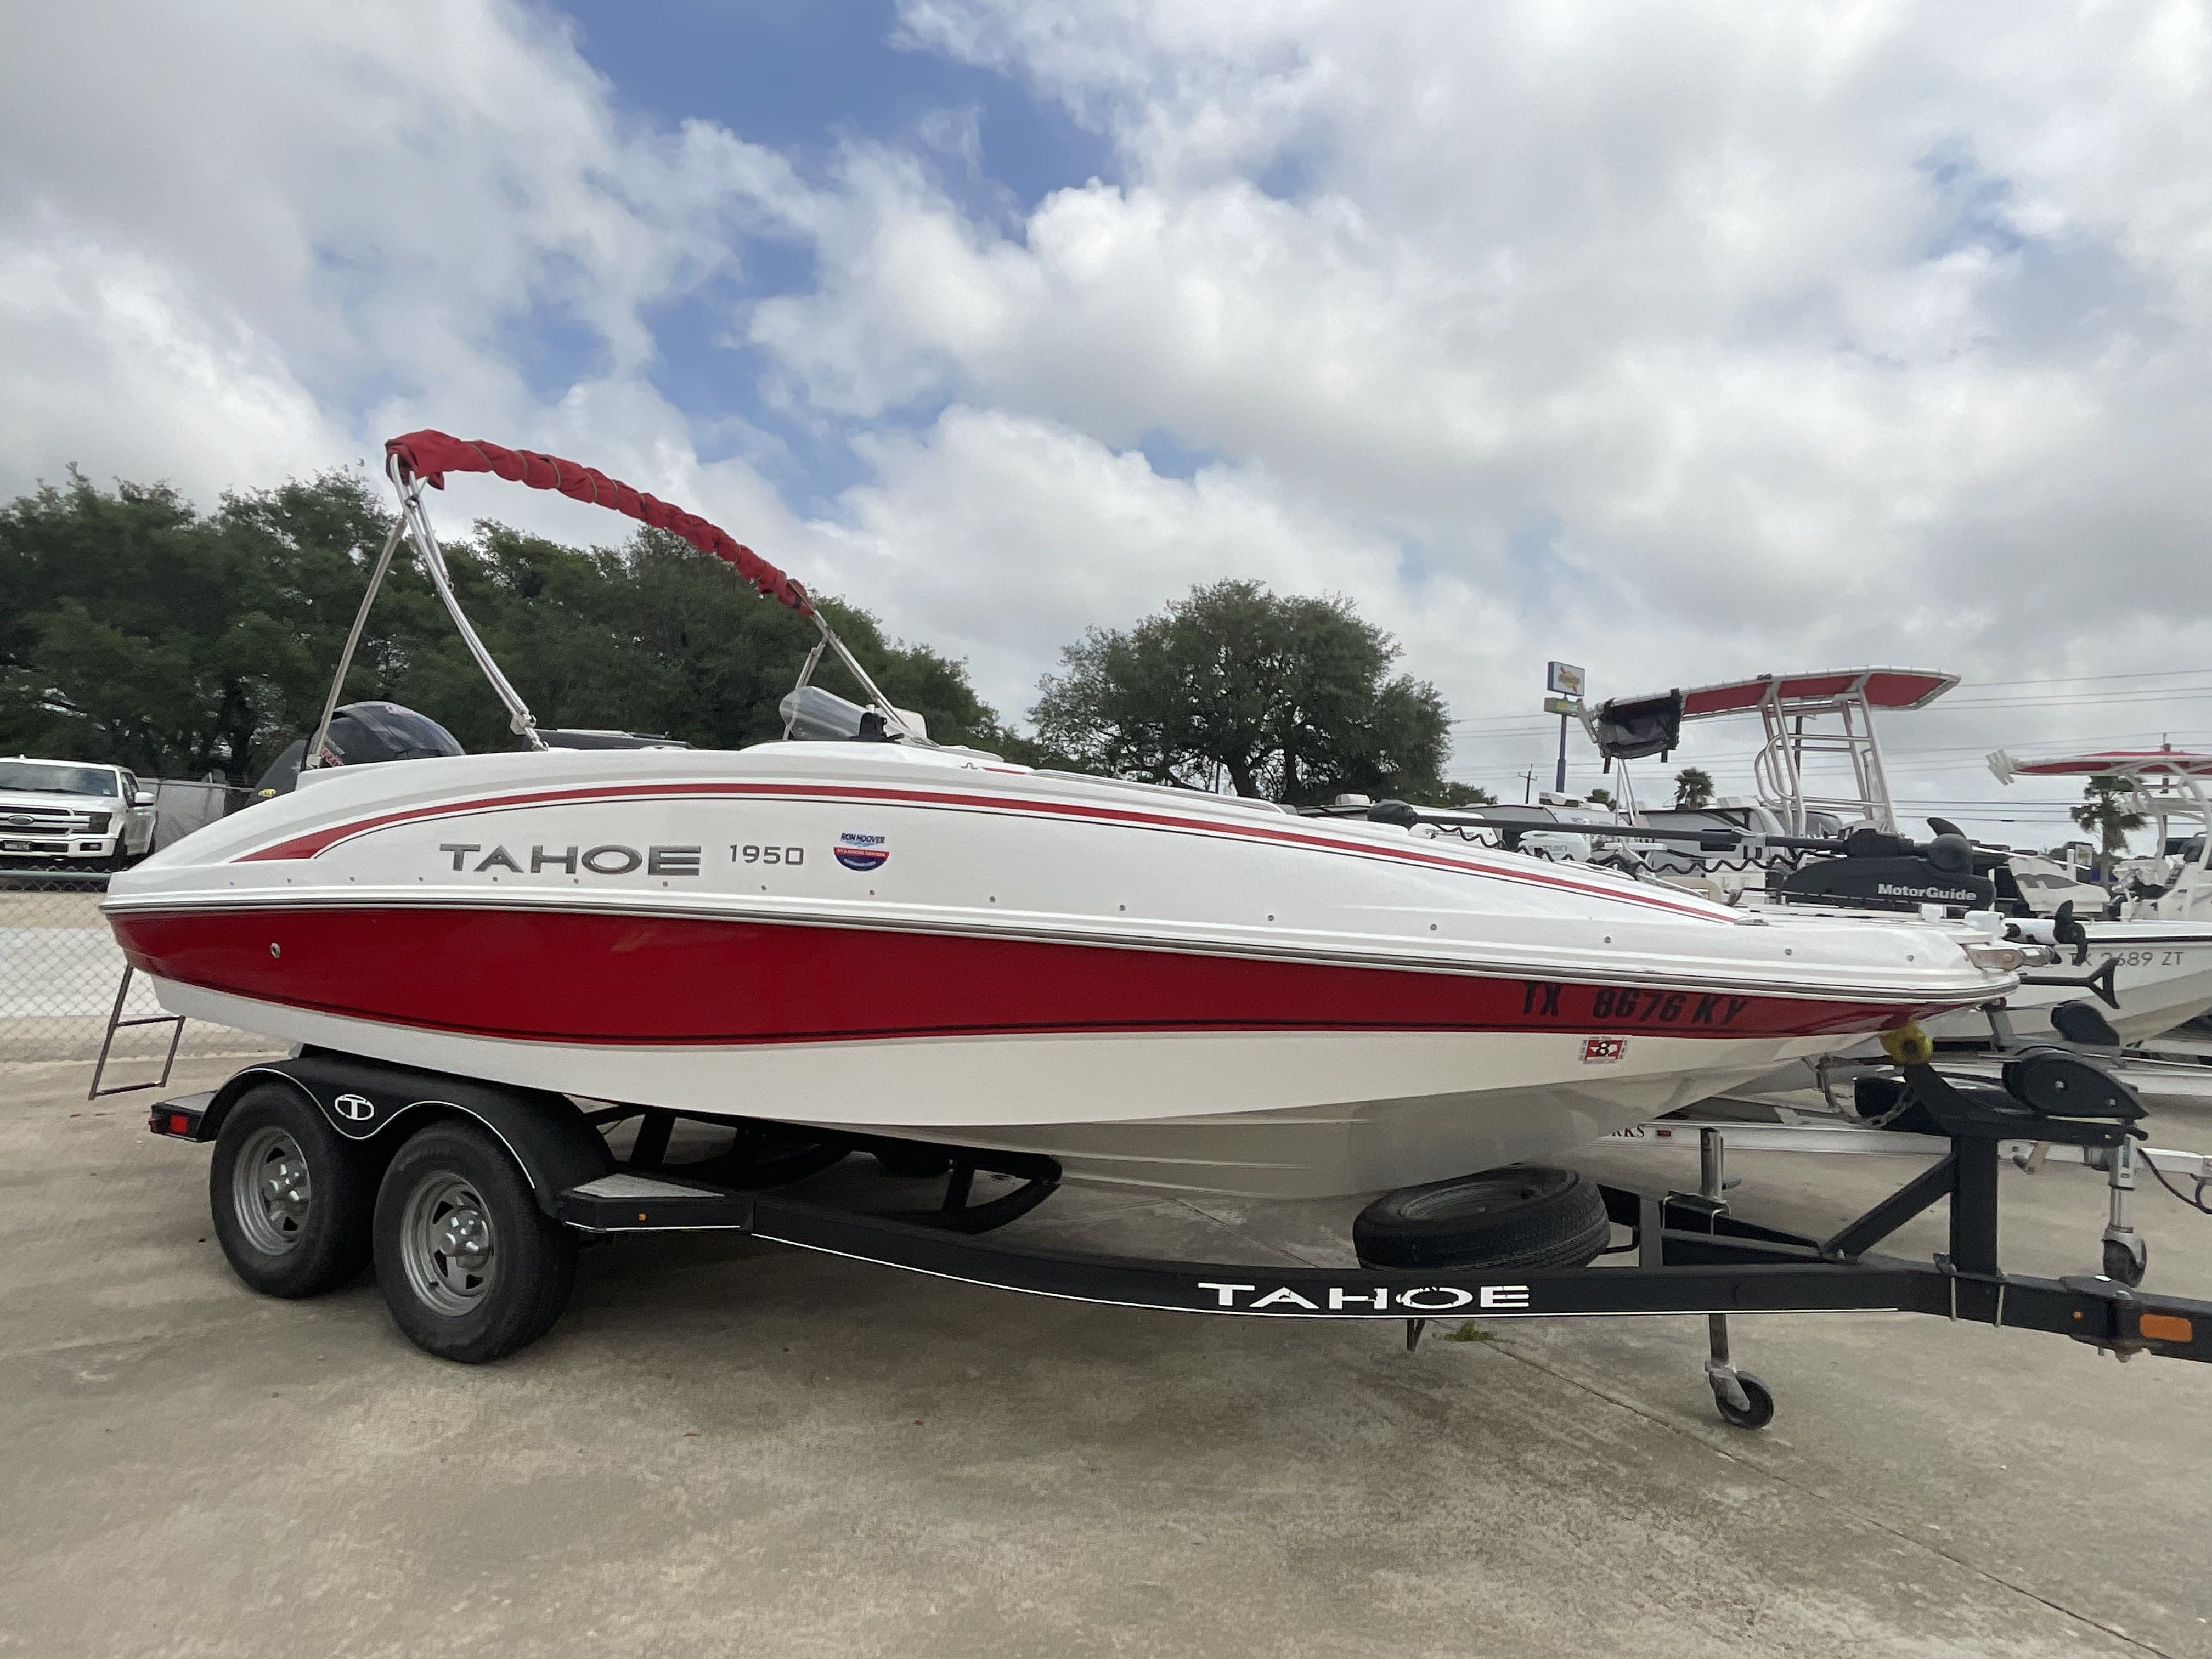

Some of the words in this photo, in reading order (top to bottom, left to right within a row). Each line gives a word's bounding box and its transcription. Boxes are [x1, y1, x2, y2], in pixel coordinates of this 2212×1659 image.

[857, 834, 885, 843] HOOVER
[439, 844, 701, 876] TAHOE
[730, 844, 804, 866] 1950
[1877, 883, 1976, 900] MotorGuide
[2162, 952, 2184, 966] ZT
[1523, 982, 1561, 1017] TX
[1593, 988, 1688, 1023] 8676
[1692, 995, 1748, 1025] KY
[1198, 1282, 1530, 1310] TAHOE
